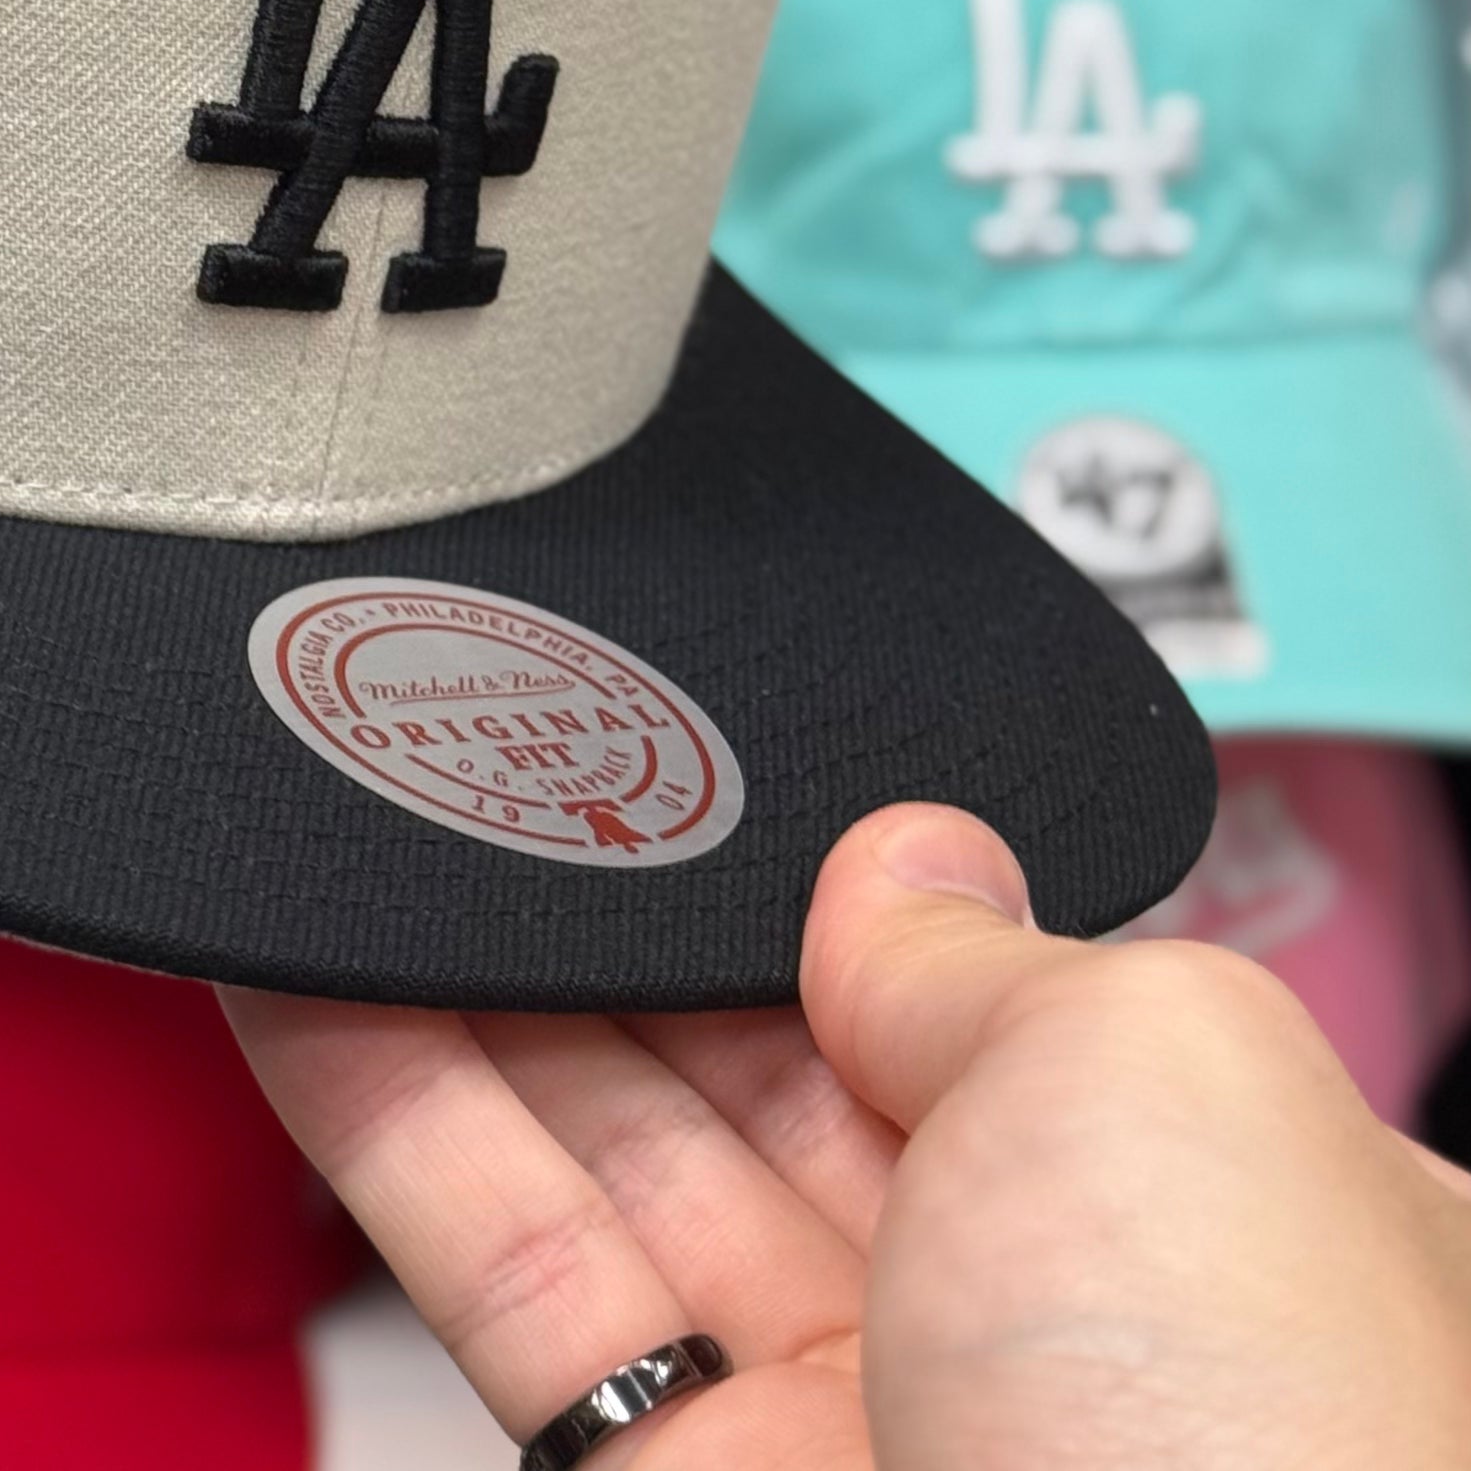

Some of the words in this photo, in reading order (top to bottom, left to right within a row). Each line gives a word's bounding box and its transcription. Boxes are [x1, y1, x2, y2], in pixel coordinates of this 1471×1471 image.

[299, 630, 347, 718] NOSTALGIA
[605, 674, 639, 697] PA
[358, 675, 475, 701] Mitchell
[481, 677, 499, 692] &
[499, 670, 576, 690] Ness
[350, 704, 670, 749] ORIGINAL
[495, 742, 580, 771] FIT
[536, 745, 633, 797] SNAPBACK
